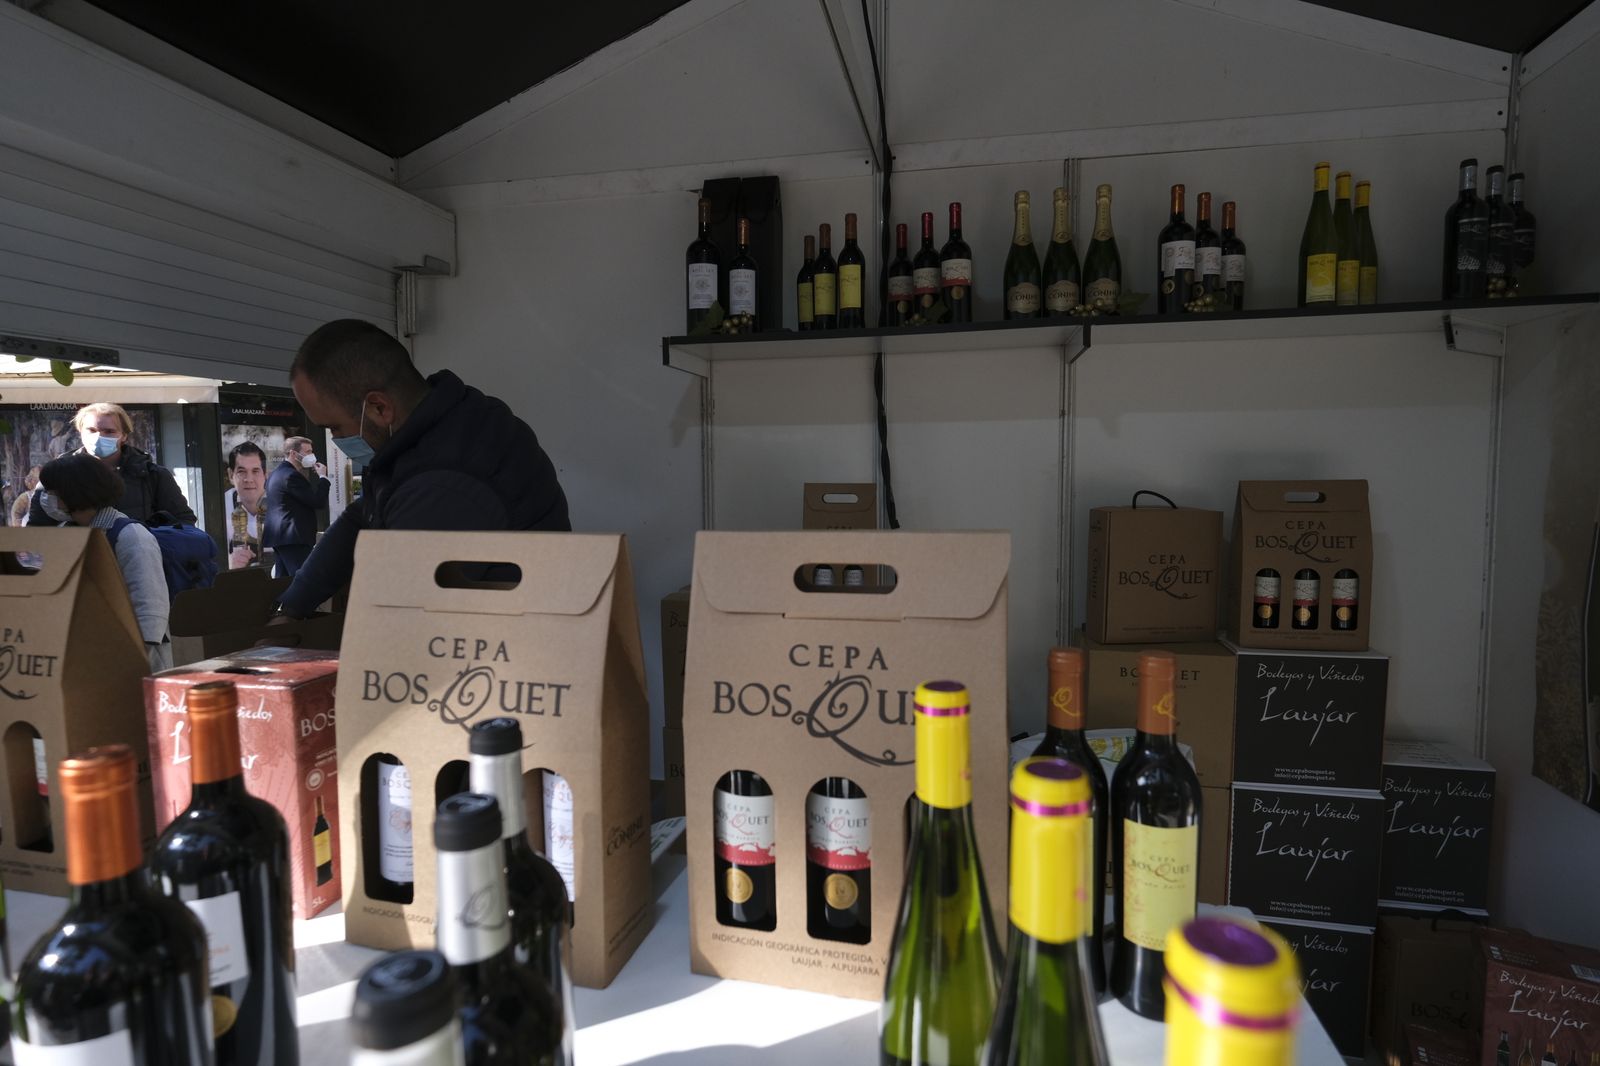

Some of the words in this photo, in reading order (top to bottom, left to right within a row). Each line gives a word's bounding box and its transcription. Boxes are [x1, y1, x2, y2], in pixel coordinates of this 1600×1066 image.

[1284, 520, 1327, 531] CEPA
[1148, 554, 1187, 565] CEPA
[1255, 530, 1358, 563] BOSQUET
[1118, 565, 1214, 600] BOSQUET
[3, 627, 24, 643] PA
[428, 636, 510, 662] CEPA
[788, 643, 888, 671] CEPA
[1256, 661, 1303, 691] Bodegas
[1307, 673, 1315, 691] y
[1319, 663, 1365, 683] Viñedos
[158, 688, 189, 714] Bode
[361, 662, 571, 748] BOSQUET
[1259, 686, 1358, 747] Laujar
[300, 707, 337, 738] BOS
[712, 671, 915, 767] BOSQU
[1384, 776, 1430, 806] Bodegas
[1433, 789, 1442, 807] y
[1252, 796, 1299, 827] Bodegas
[1303, 810, 1310, 828] y
[1315, 801, 1361, 823] Viñedos
[1386, 799, 1485, 860] Laujar
[1255, 820, 1353, 882] Laujar
[711, 932, 764, 948] INDICACIÓN
[822, 948, 874, 963] PROTEGIDA
[1304, 934, 1349, 955] Viñedos
[791, 956, 823, 969] LAUJAR
[1508, 989, 1591, 1039] Laujar
